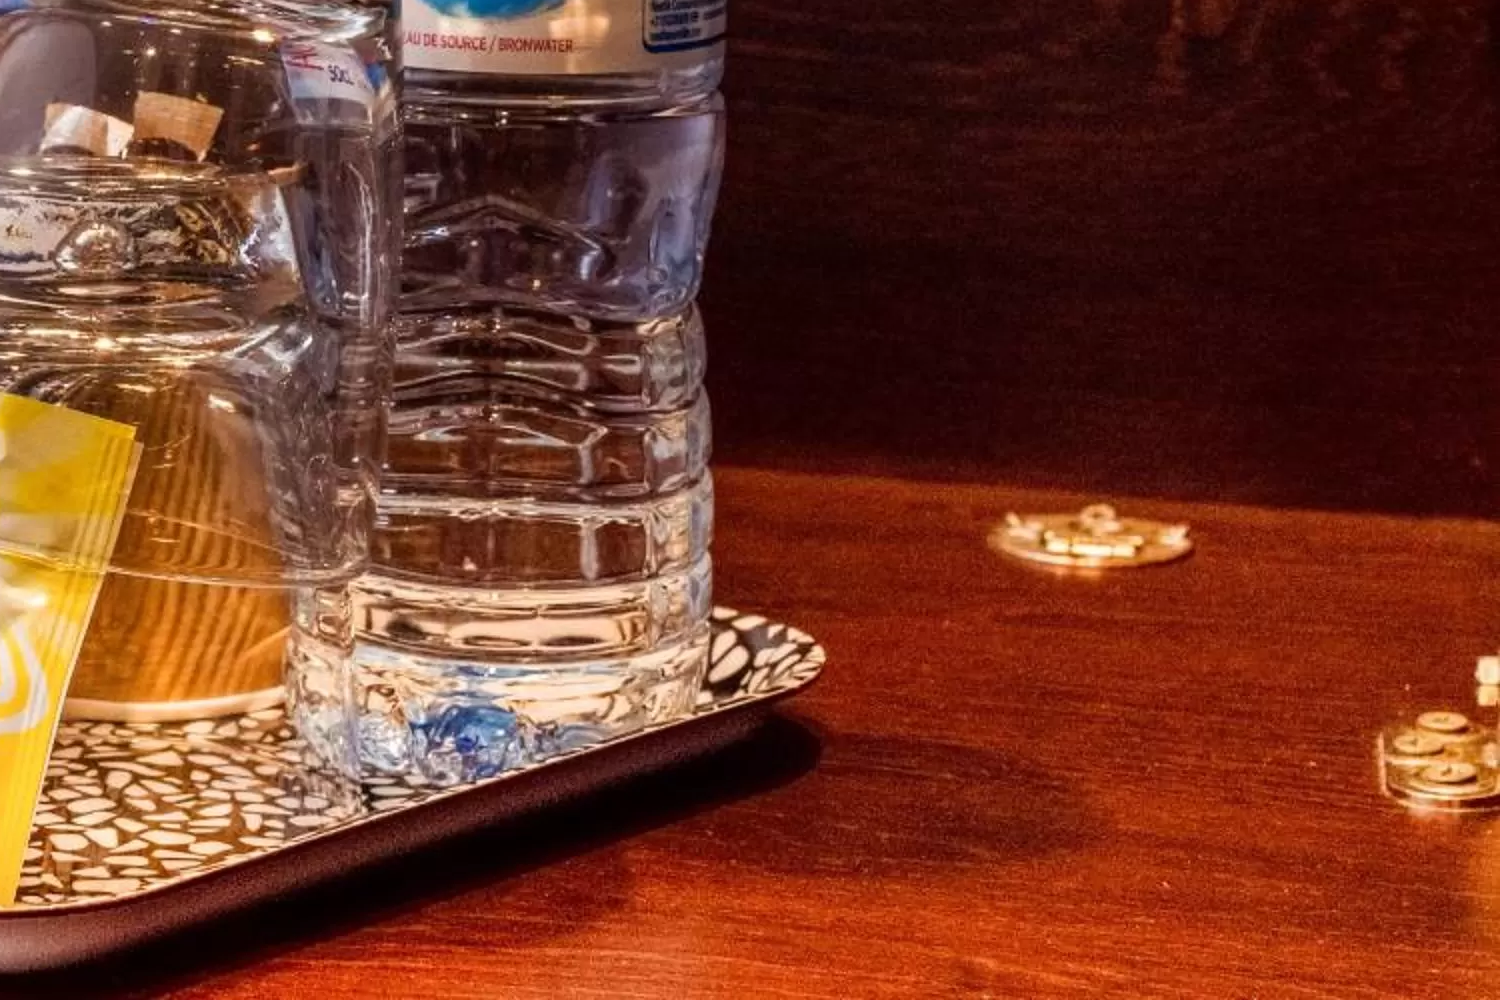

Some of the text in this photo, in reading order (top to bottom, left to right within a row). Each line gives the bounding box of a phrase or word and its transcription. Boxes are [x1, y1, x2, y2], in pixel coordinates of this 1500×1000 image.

[423, 33, 438, 47] DE
[441, 35, 487, 51] SOURCE
[499, 37, 574, 53] BRONWATER
